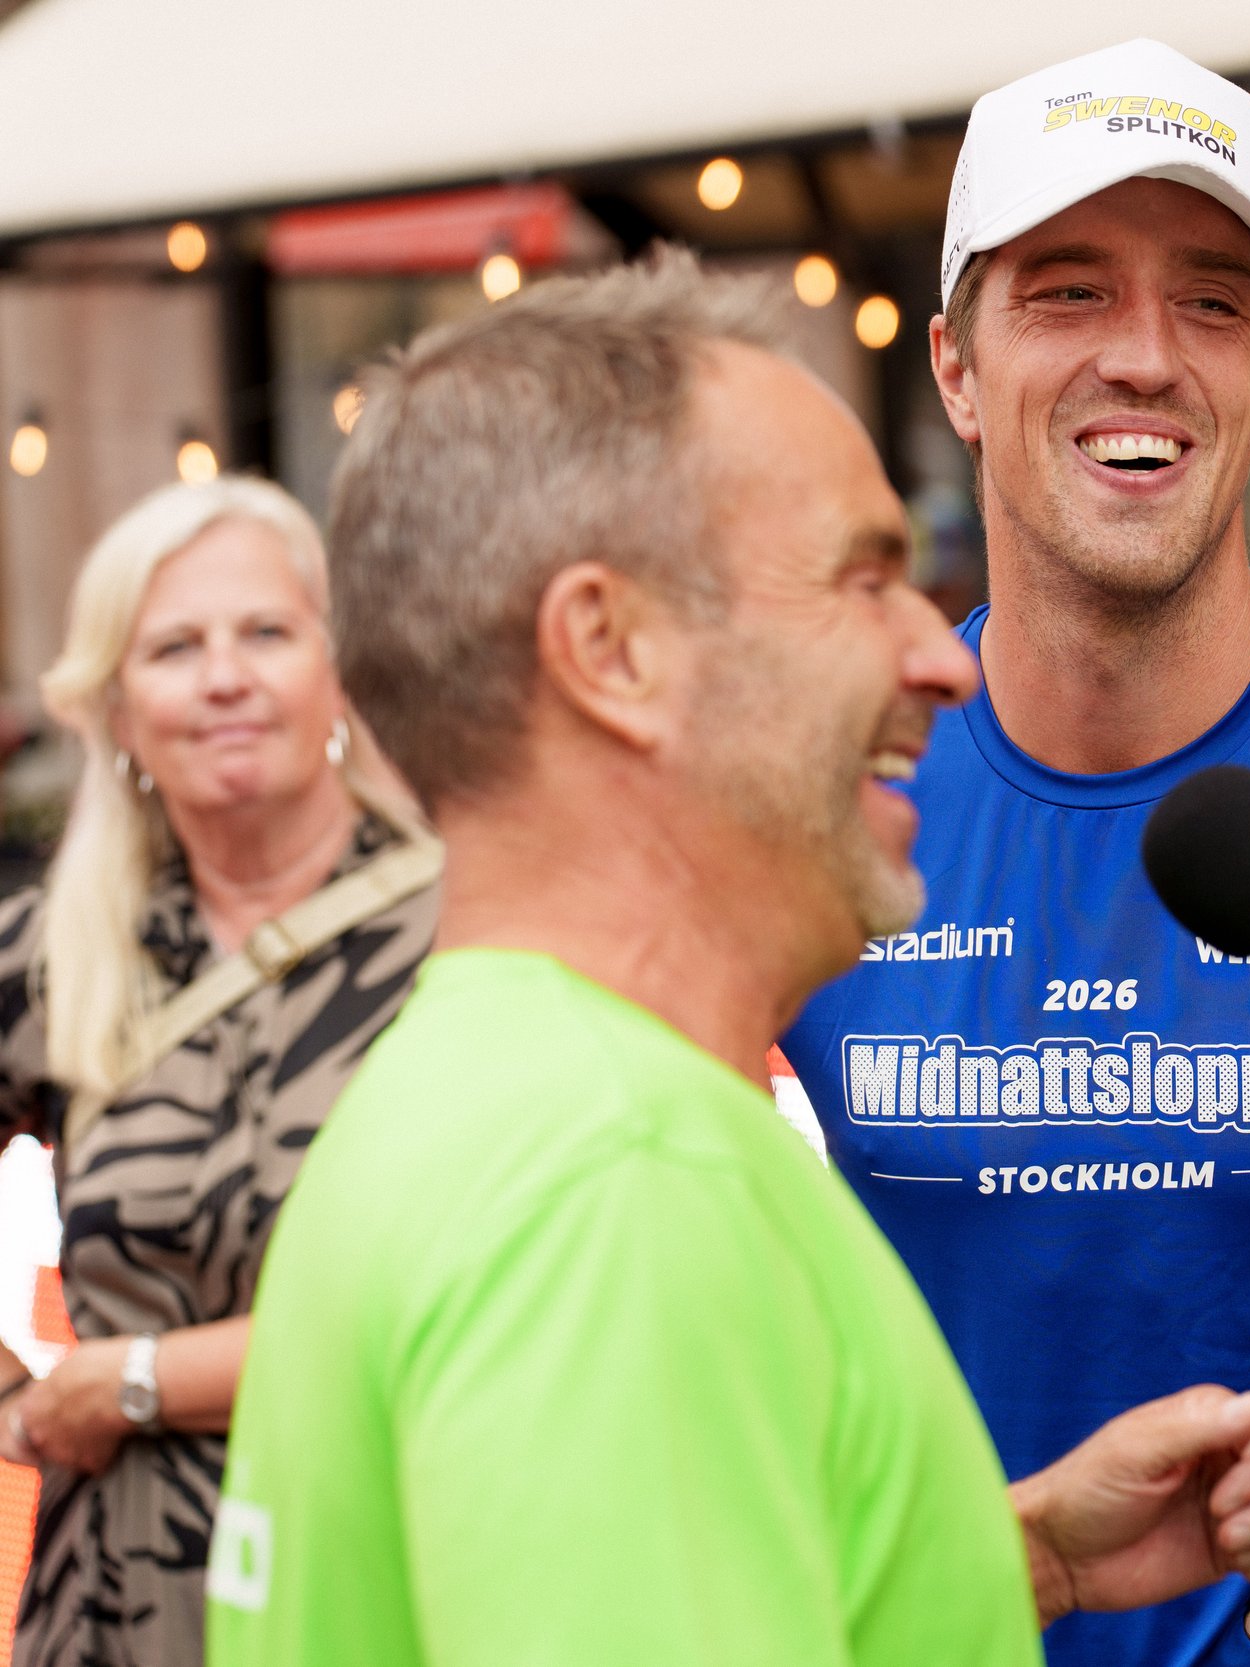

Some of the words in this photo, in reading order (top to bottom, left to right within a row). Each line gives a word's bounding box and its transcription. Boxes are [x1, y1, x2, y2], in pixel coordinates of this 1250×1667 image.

[1045, 91, 1092, 110] Team
[1043, 96, 1237, 149] SWENOR
[1107, 117, 1236, 166] SPLITKON
[1043, 980, 1138, 1011] 2026
[978, 1160, 1216, 1195] STOCKHOLM
